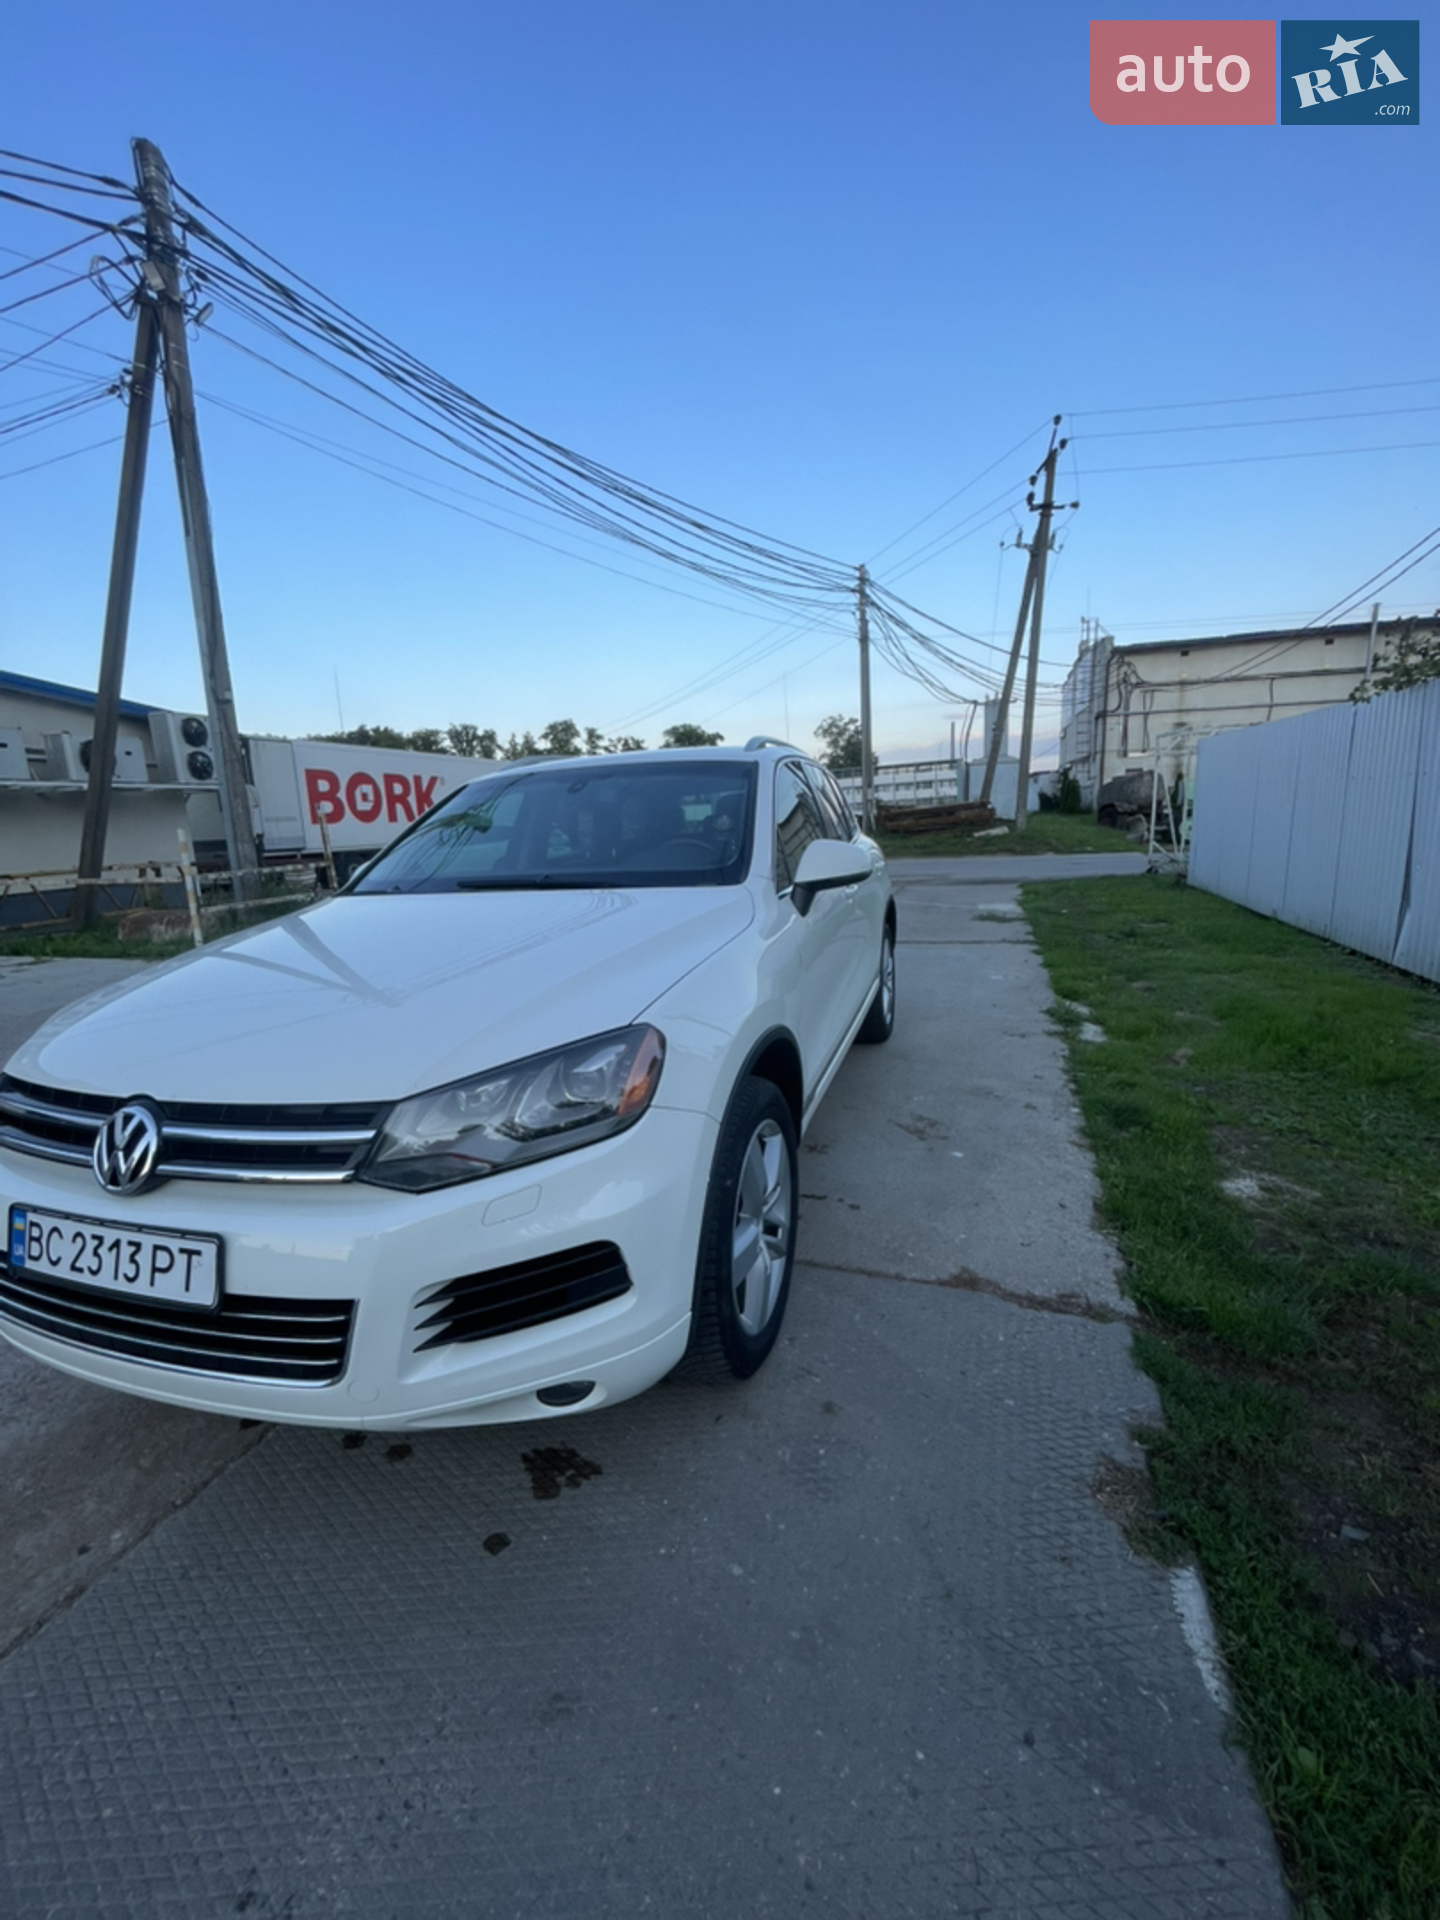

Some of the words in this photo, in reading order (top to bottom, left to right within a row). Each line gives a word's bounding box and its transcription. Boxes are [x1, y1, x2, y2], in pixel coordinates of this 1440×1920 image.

[304, 768, 439, 825] BORK
[28, 1220, 64, 1267] BC
[70, 1231, 142, 1283] 2313
[150, 1245, 202, 1292] PT
